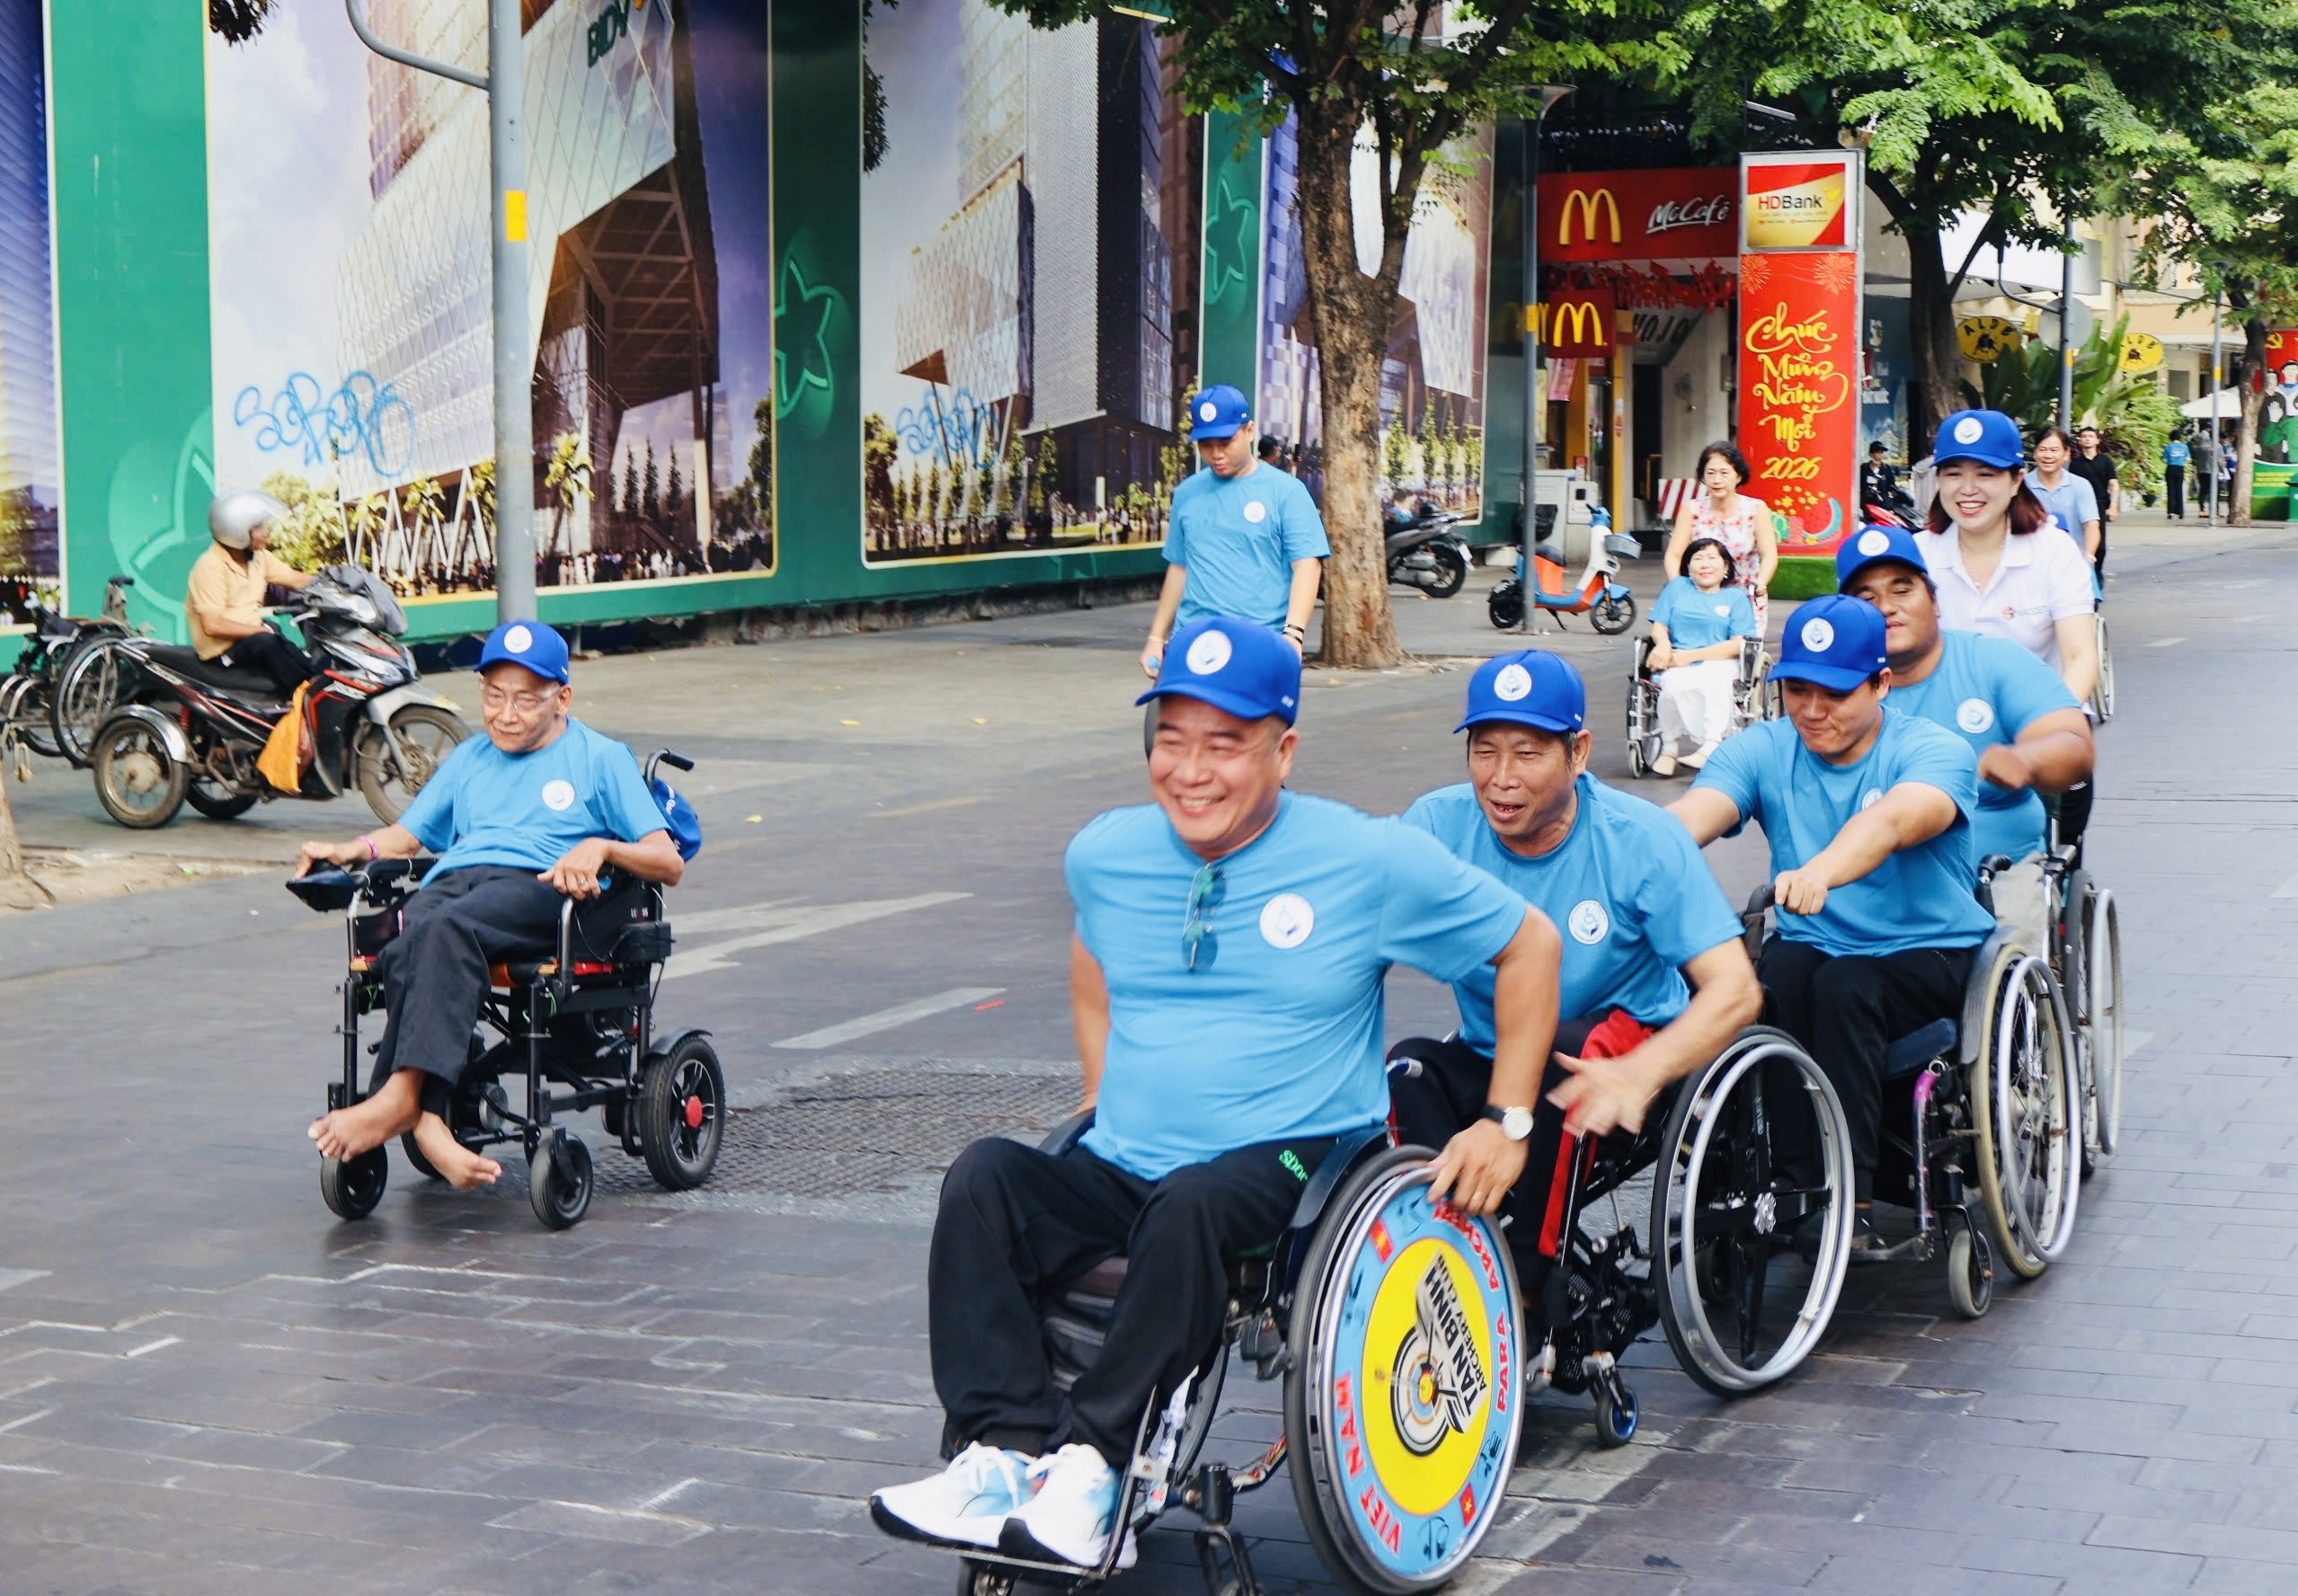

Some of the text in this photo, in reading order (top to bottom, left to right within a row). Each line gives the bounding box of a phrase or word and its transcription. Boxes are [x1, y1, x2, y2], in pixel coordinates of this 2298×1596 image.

[1646, 194, 1731, 234] McCafé
[1758, 194, 1823, 209] HDBank
[1745, 301, 1839, 353] Chúc
[1760, 457, 1824, 480] 2026
[1495, 1308, 1510, 1414] PARA
[1335, 1370, 1367, 1480] NAM
